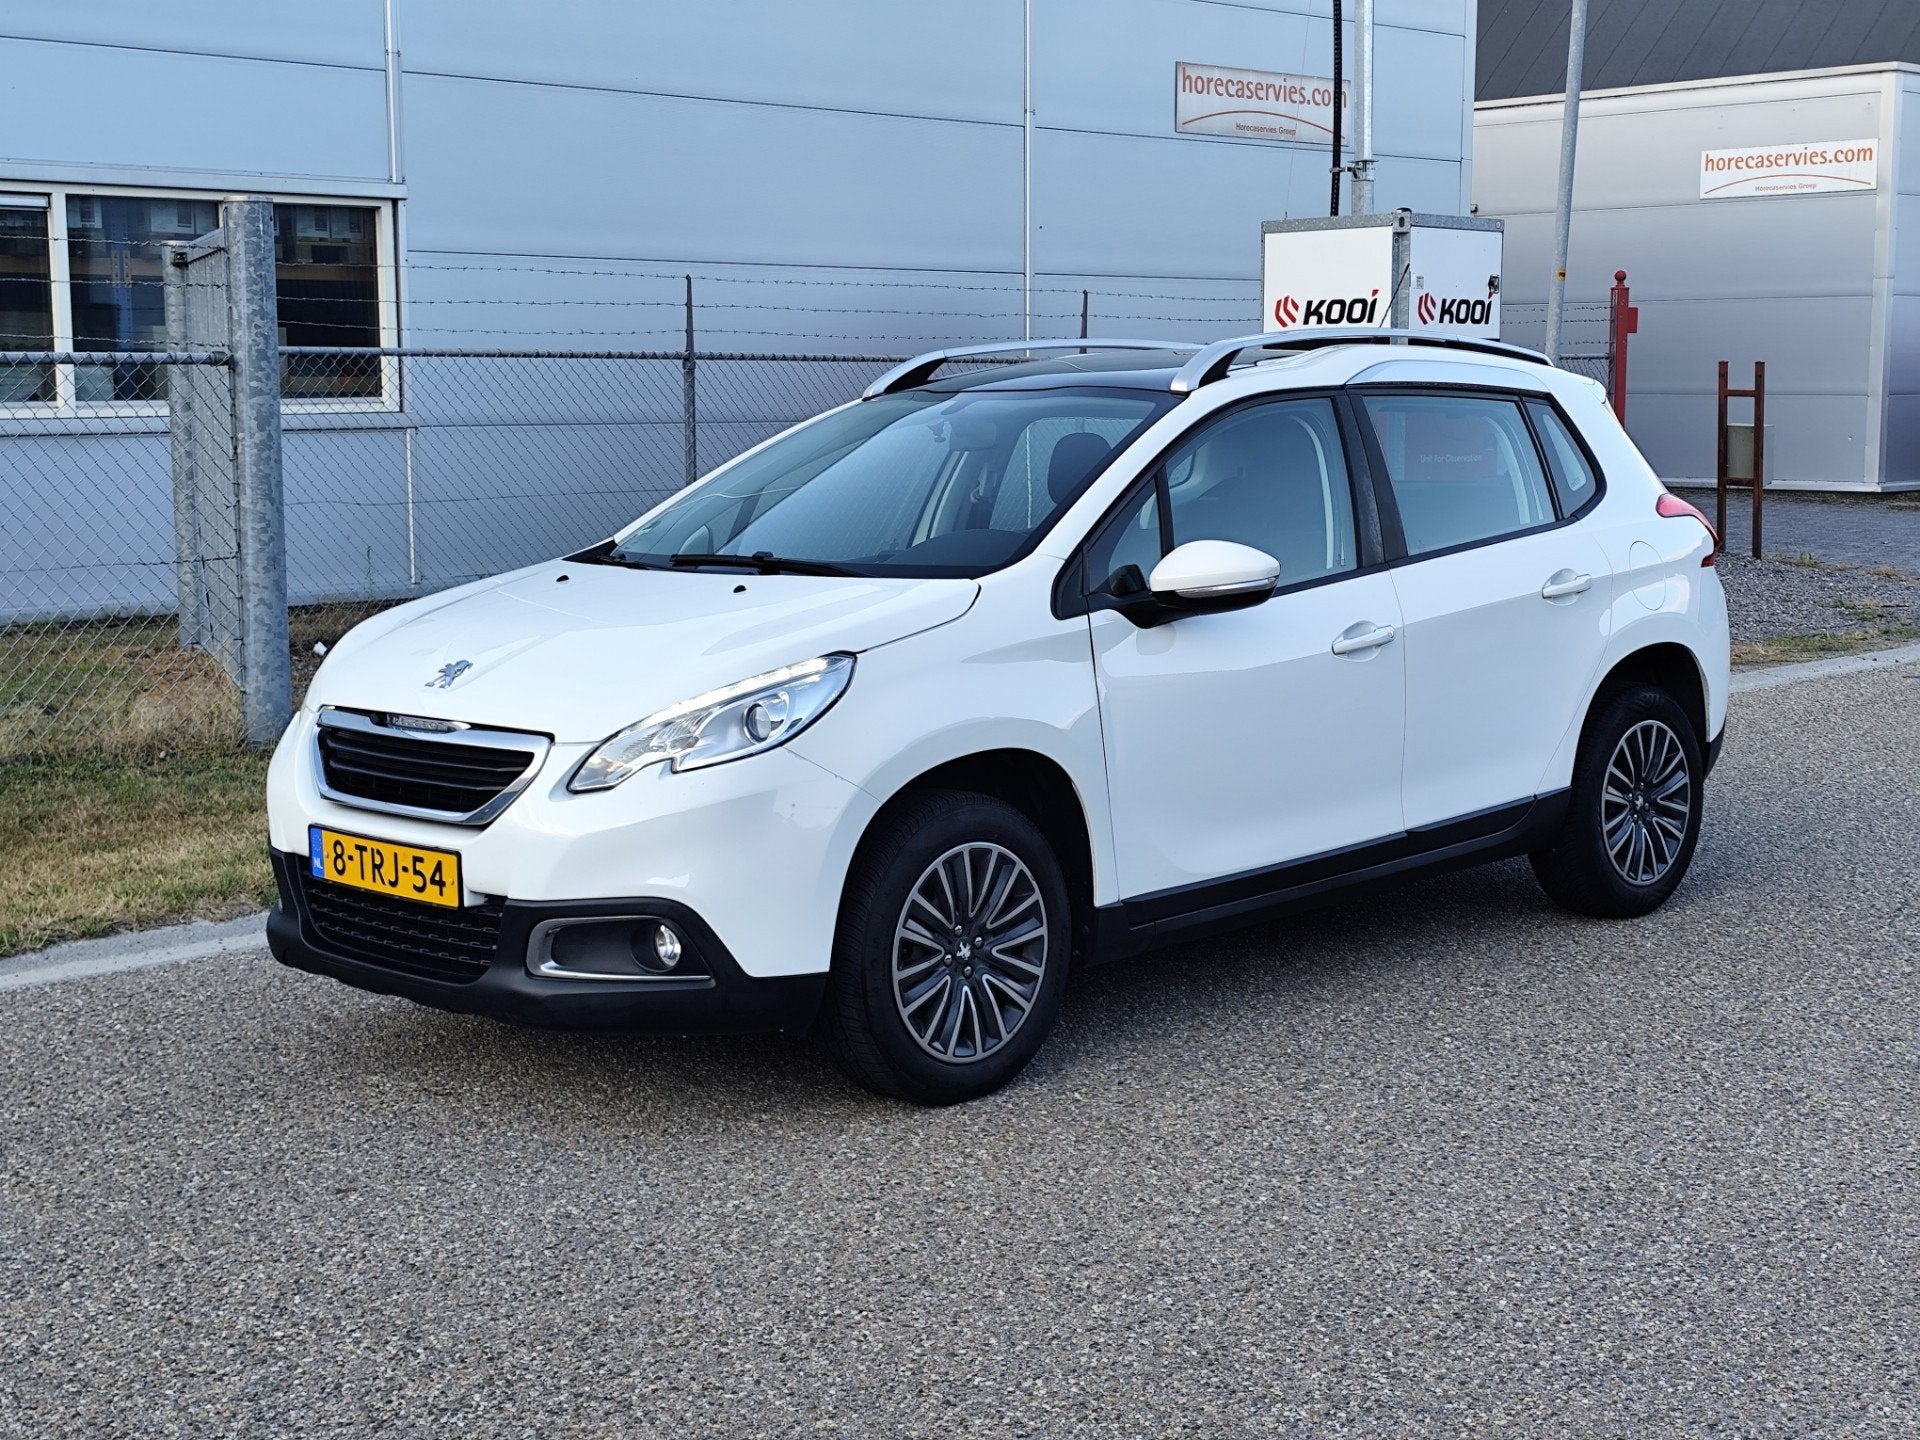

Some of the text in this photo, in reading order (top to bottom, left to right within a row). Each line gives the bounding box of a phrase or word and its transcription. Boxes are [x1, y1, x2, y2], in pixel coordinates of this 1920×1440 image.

[1235, 122, 1297, 137] Horecaservies Groep
[1705, 147, 1873, 172] horecaservies.com
[1755, 182, 1817, 192] Horecaservies Groep
[313, 857, 323, 869] NL
[333, 839, 446, 896] 8-TRJ-54
